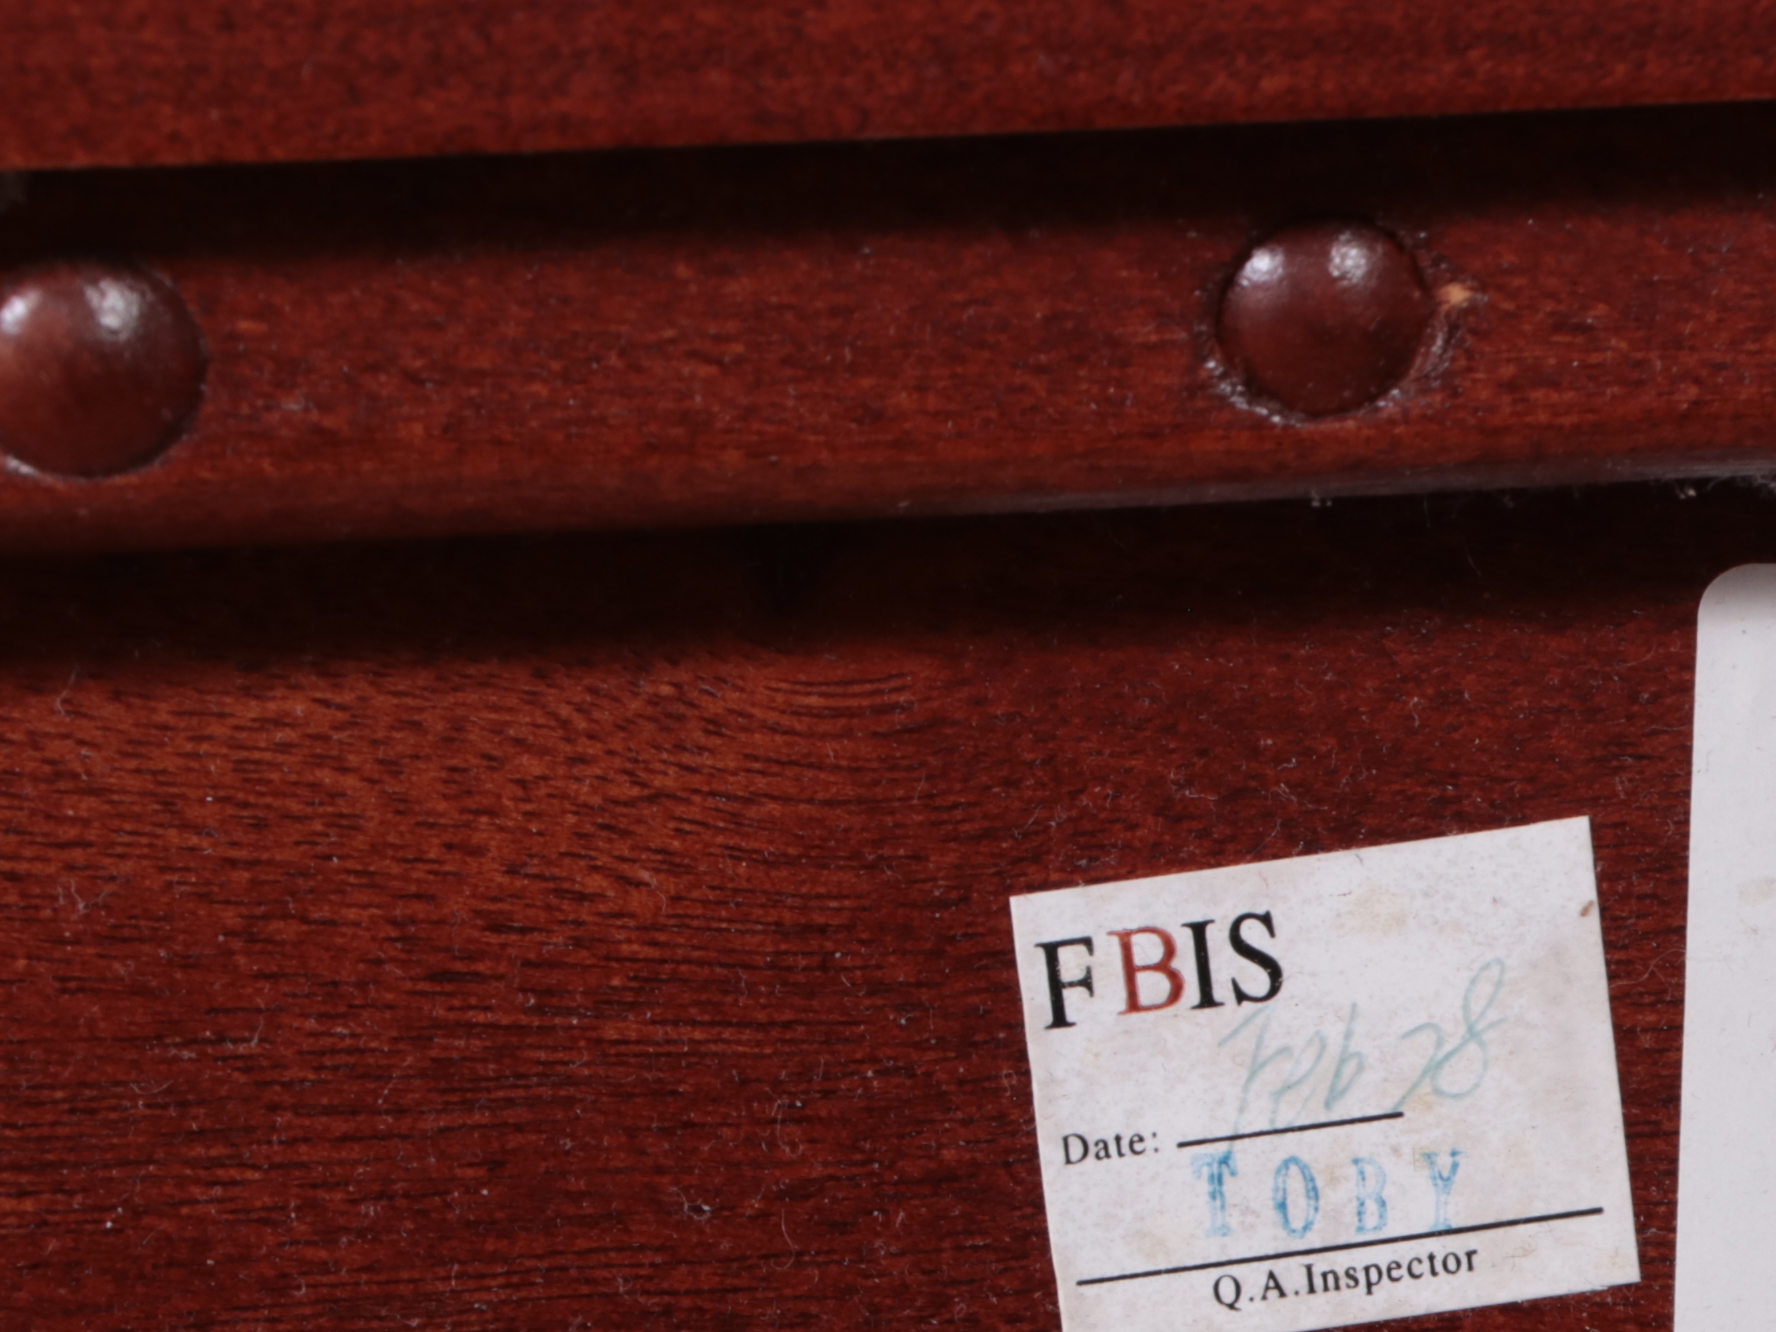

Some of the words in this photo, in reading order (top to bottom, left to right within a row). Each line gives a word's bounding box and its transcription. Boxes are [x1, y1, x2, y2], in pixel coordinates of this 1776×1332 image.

[1035, 910, 1283, 1030] FBIS
[1061, 1129, 1160, 1165] Date:
[1191, 1149, 1466, 1240] TOBY
